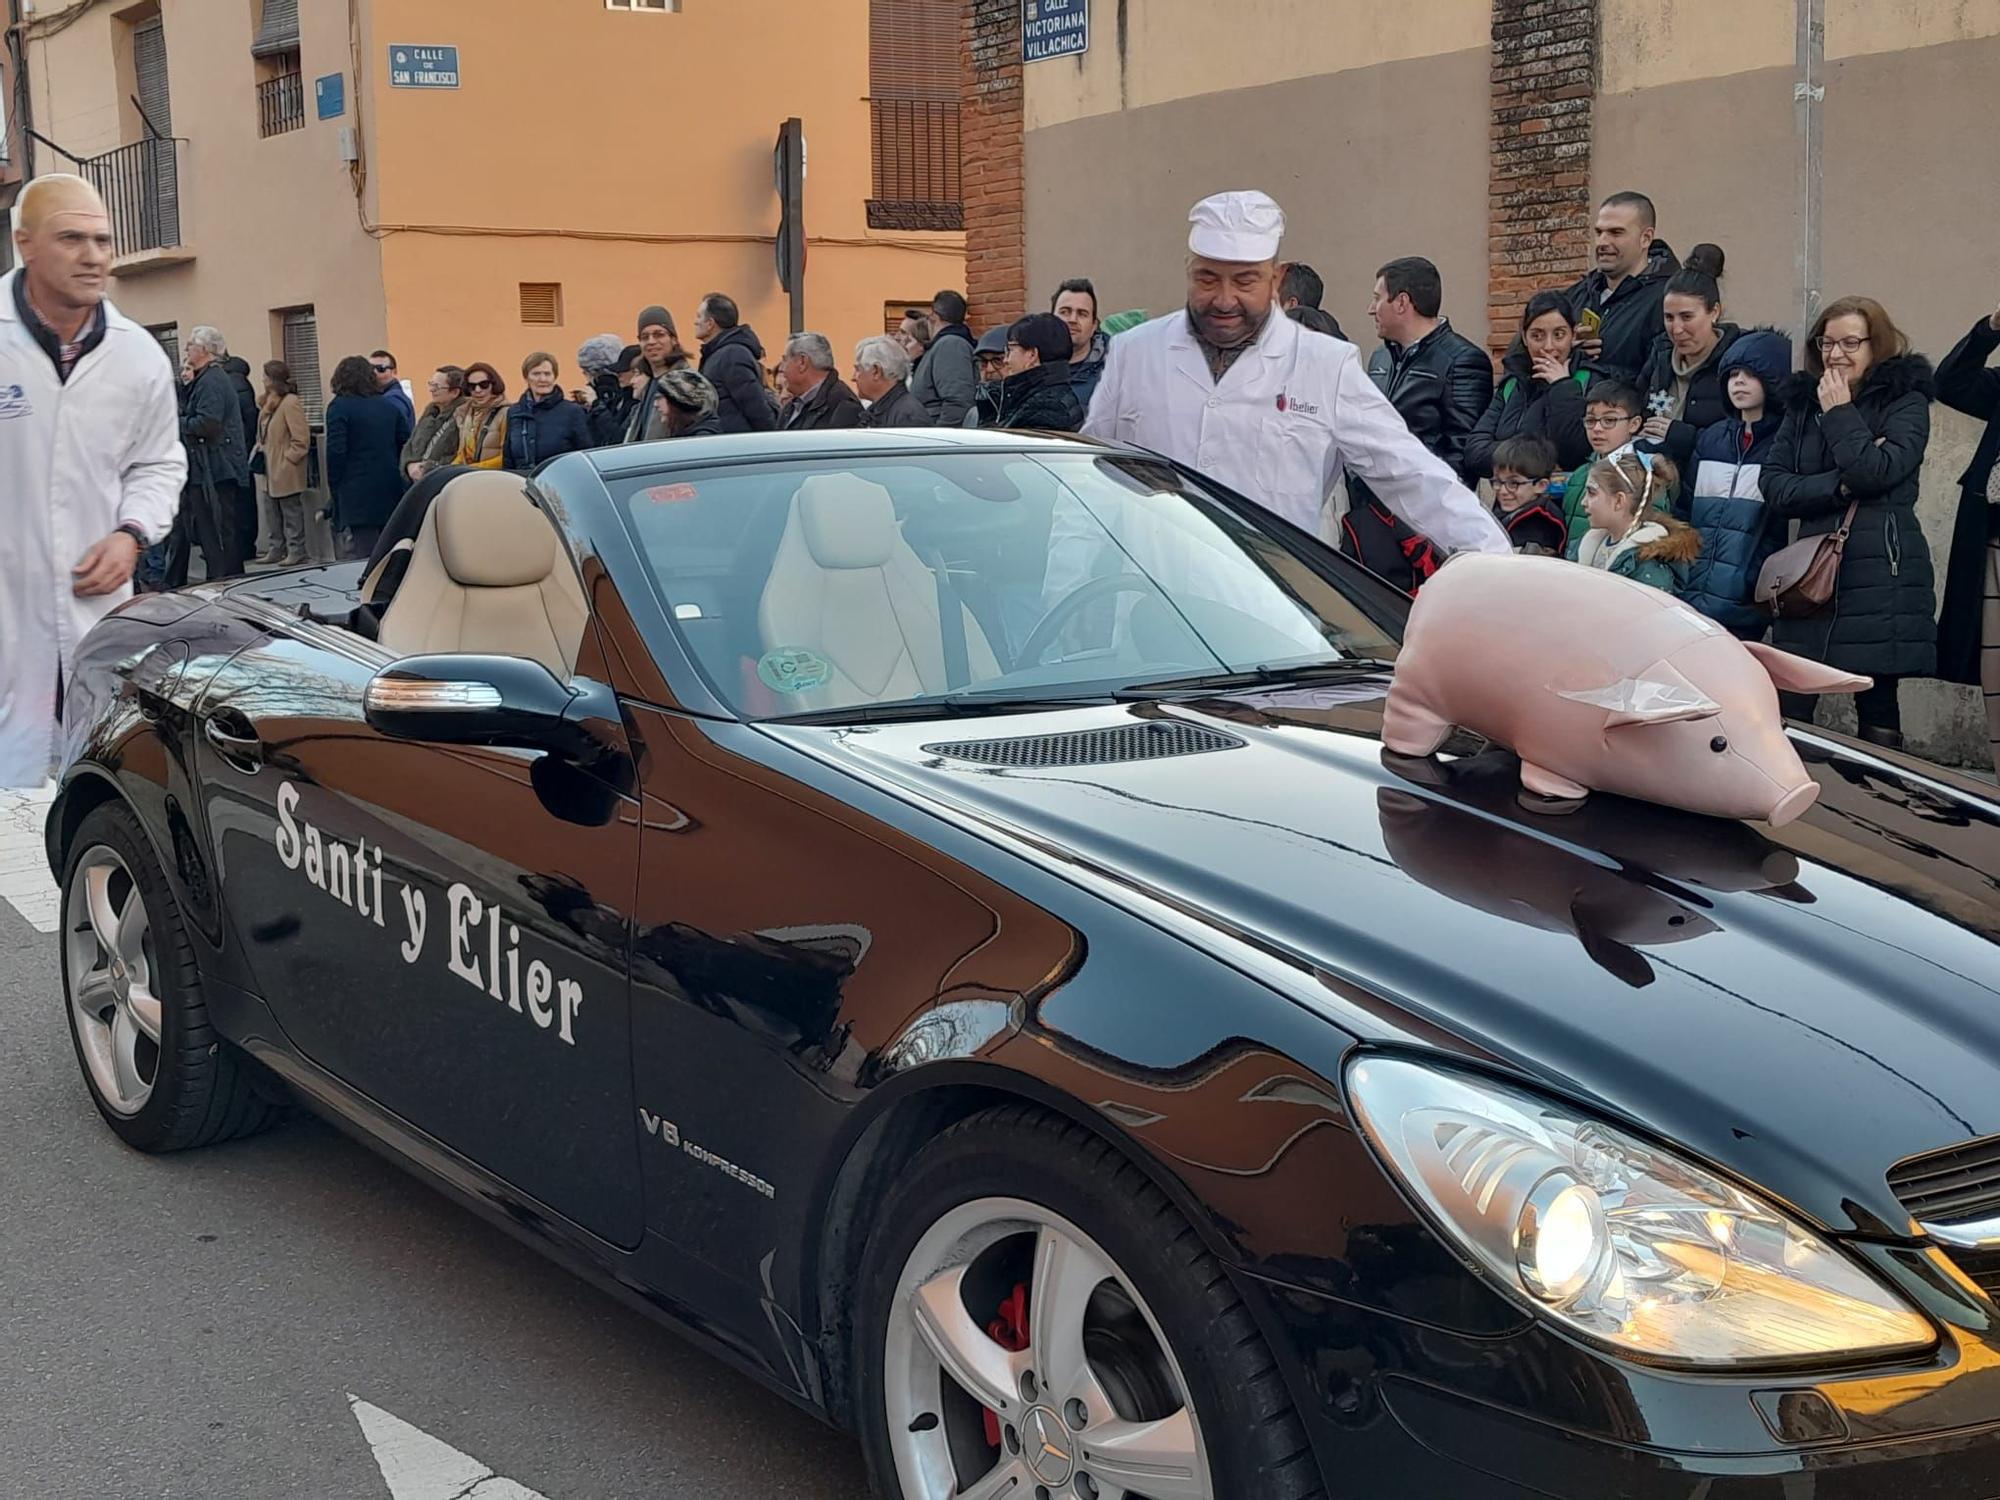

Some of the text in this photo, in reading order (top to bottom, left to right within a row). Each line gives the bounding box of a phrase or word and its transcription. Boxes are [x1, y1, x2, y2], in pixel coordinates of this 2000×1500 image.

[1044, 0, 1069, 12] CALLE
[1025, 11, 1085, 38] VICTORIANA
[414, 49, 444, 60] CALLE
[1027, 32, 1084, 58] VILLACHICA
[393, 70, 457, 85] SAN FRANCISCO
[275, 780, 385, 927] Santi
[399, 883, 427, 964] y
[446, 882, 584, 1046] Elier
[683, 1140, 776, 1200] KOMPRESSOR
